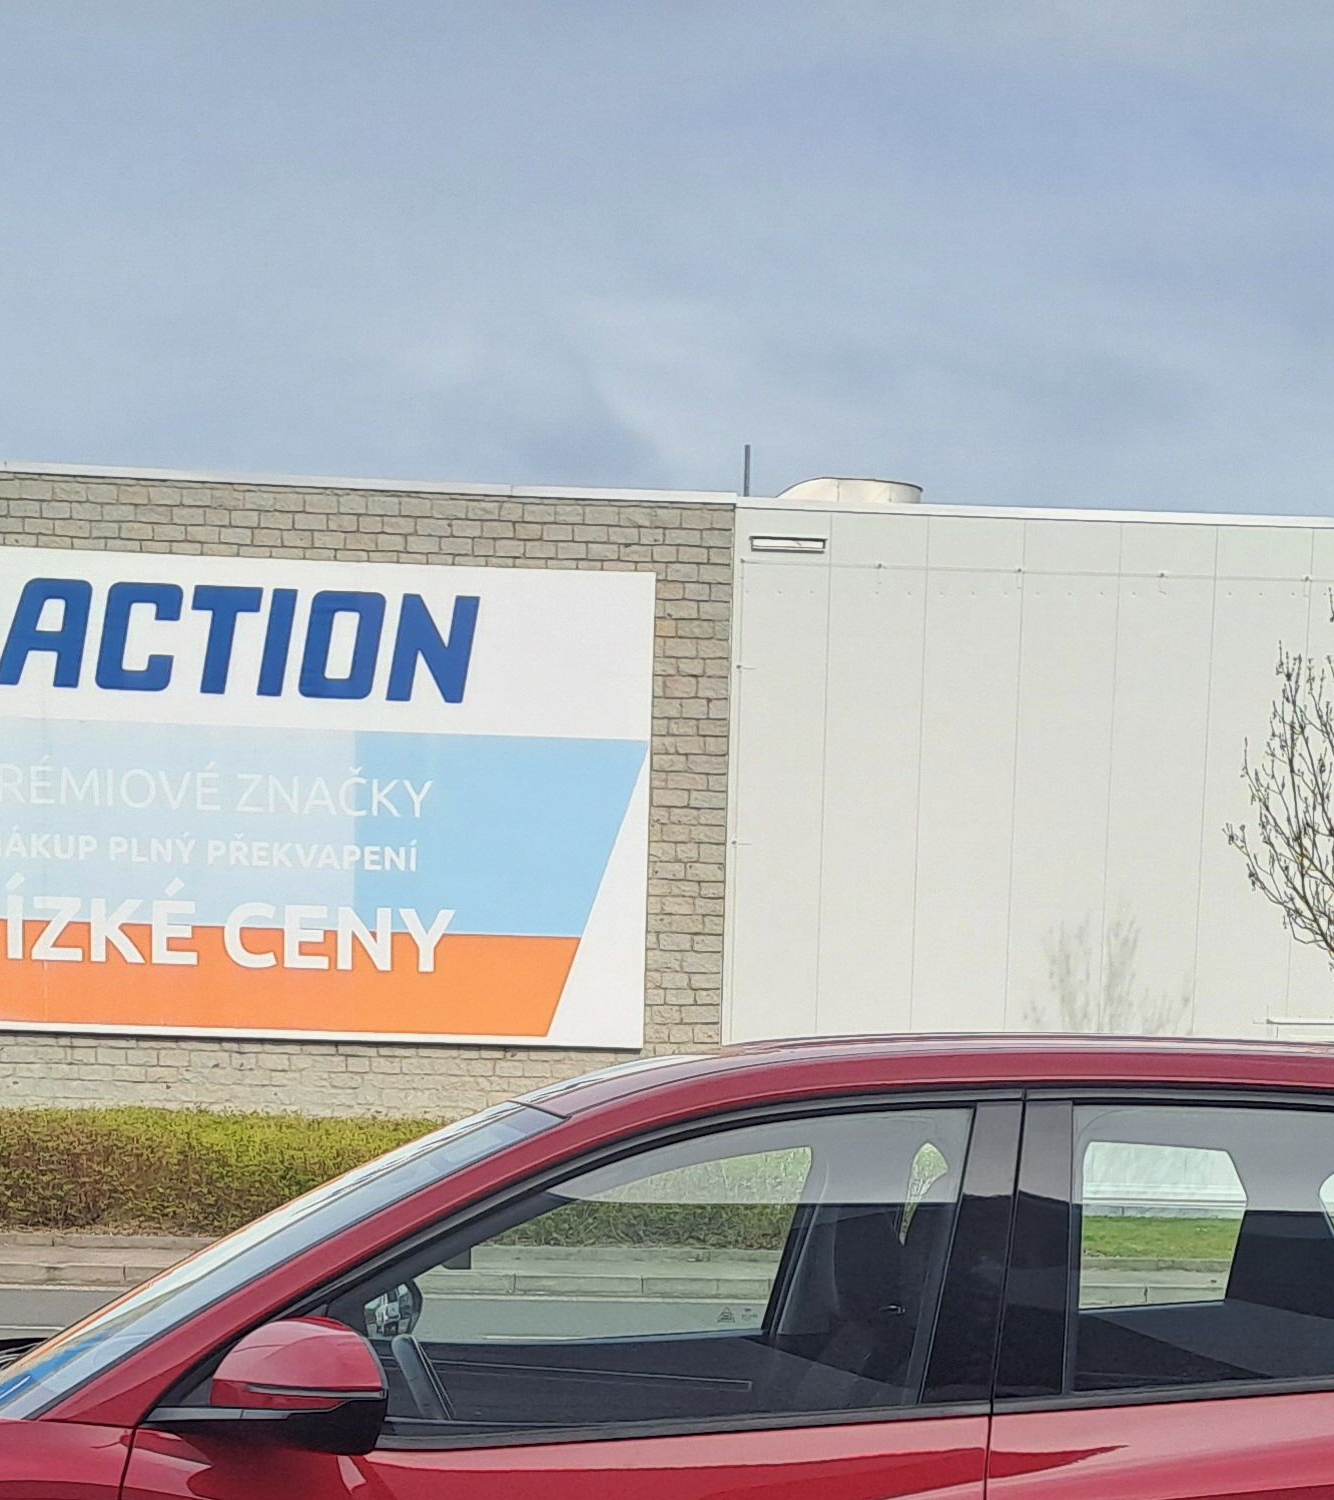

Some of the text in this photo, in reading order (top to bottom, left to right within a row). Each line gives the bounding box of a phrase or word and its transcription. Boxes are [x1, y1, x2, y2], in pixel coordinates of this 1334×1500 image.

[236, 766, 434, 818] ZNAČKY
[109, 832, 196, 864] PLNÝ
[207, 834, 419, 872] PŘEKVAPENÍ
[223, 901, 456, 973] CENY
